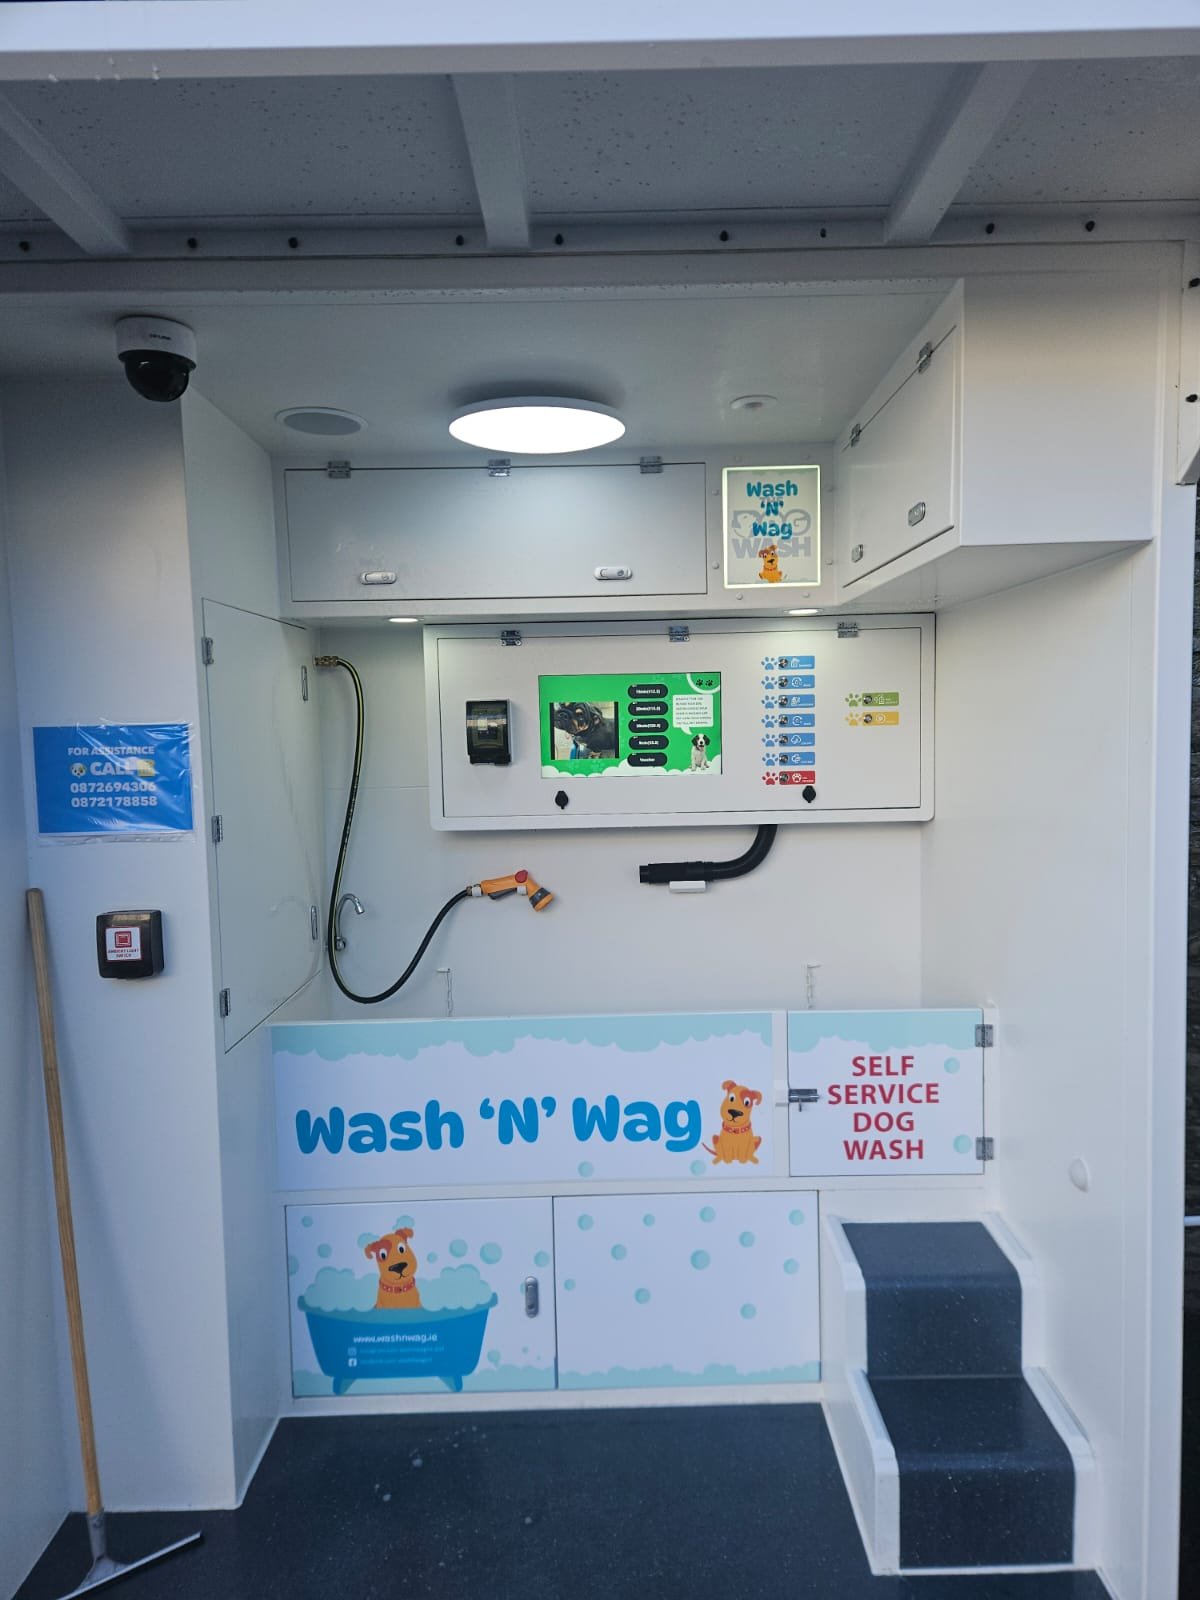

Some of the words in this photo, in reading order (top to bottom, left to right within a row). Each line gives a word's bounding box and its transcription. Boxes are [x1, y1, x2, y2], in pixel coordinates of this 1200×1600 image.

[746, 480, 798, 497] Wash
[752, 521, 793, 540] Wag
[67, 747, 90, 756] FOR
[91, 746, 155, 756] ASSISTANCE
[70, 782, 157, 793] 0872694306
[71, 796, 158, 807] 0872178858
[852, 1056, 915, 1077] SELF
[827, 1083, 940, 1105] SERVICE
[295, 1099, 464, 1155] Wash
[571, 1095, 702, 1153] Wag
[853, 1112, 915, 1133] DOG
[843, 1139, 924, 1160] WASH
[353, 1333, 438, 1344] www.washnwag.ie
